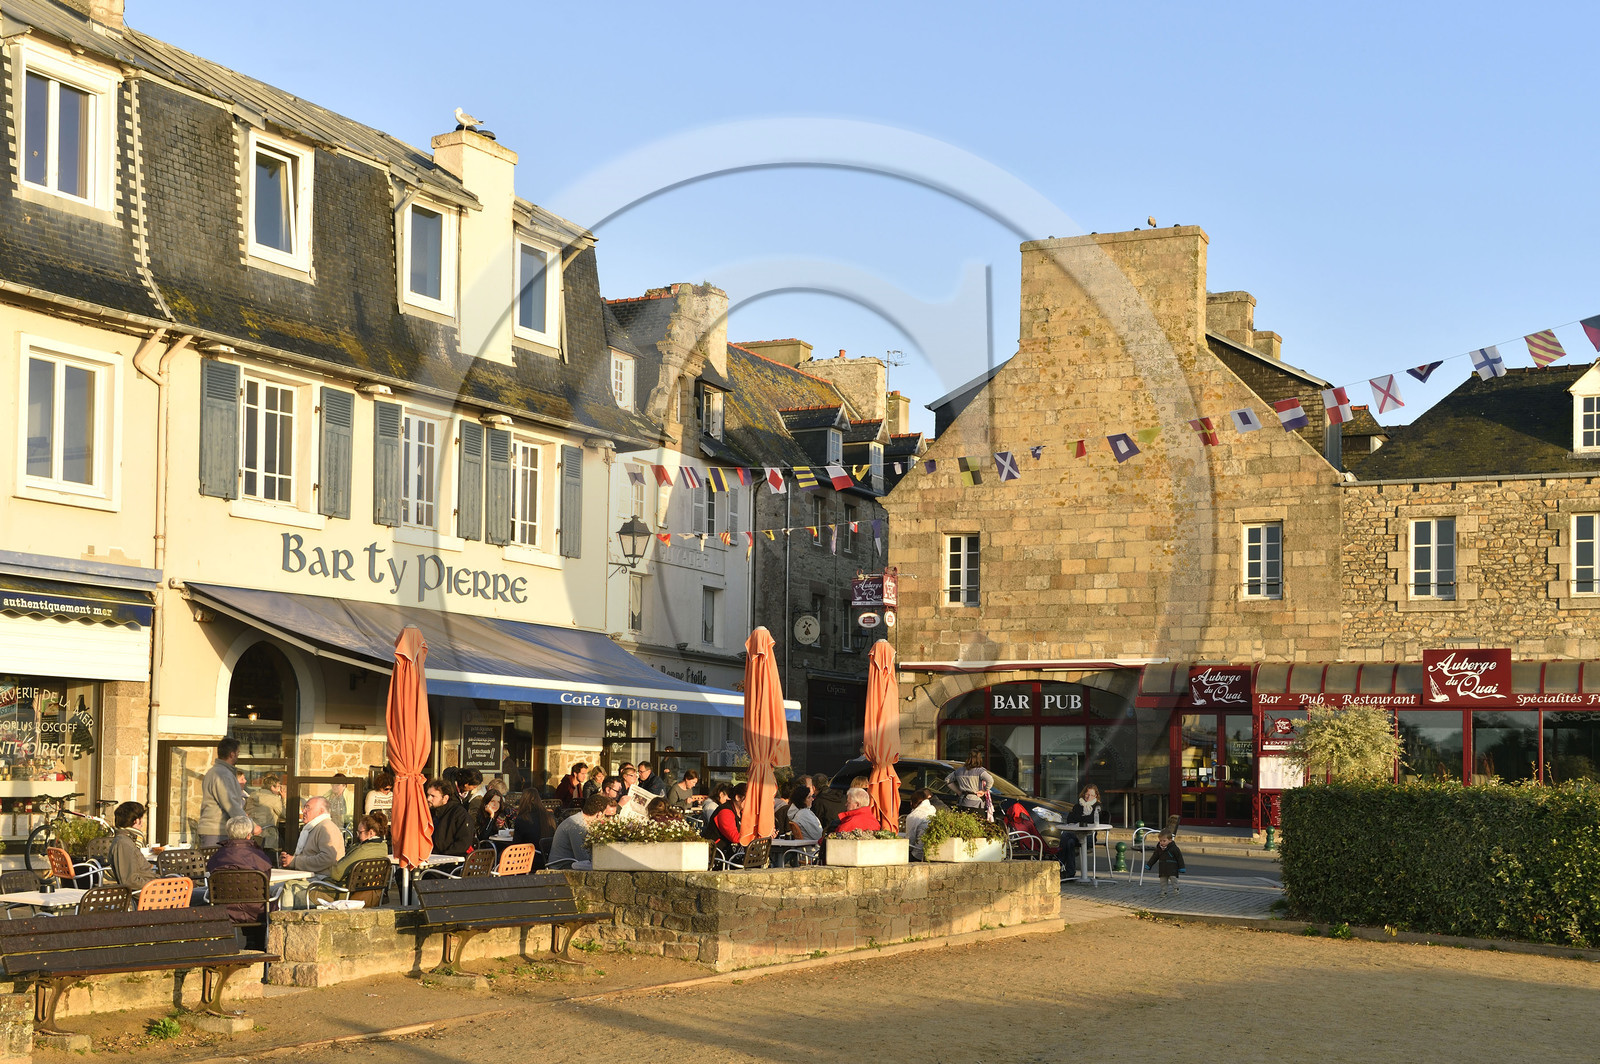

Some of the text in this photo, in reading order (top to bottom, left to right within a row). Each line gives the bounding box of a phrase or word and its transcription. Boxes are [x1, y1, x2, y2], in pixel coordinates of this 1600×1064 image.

[3, 597, 91, 614] authentiquement
[1428, 652, 1497, 676] Auberge
[1191, 667, 1241, 686] Auberge
[1445, 676, 1459, 686] du
[1204, 686, 1214, 694] du
[1211, 684, 1248, 704] Quai
[1456, 674, 1507, 700] Quai
[560, 692, 600, 707] Café
[993, 694, 1082, 710] BAR PUB
[1258, 694, 1281, 704] Bar
[1299, 692, 1325, 705] Pub
[1342, 694, 1417, 705] Restaurant
[1516, 693, 1582, 706] Spécialités
[0, 687, 94, 729] RVERIE DE LA MER
[36, 722, 78, 733] ROSCOFF
